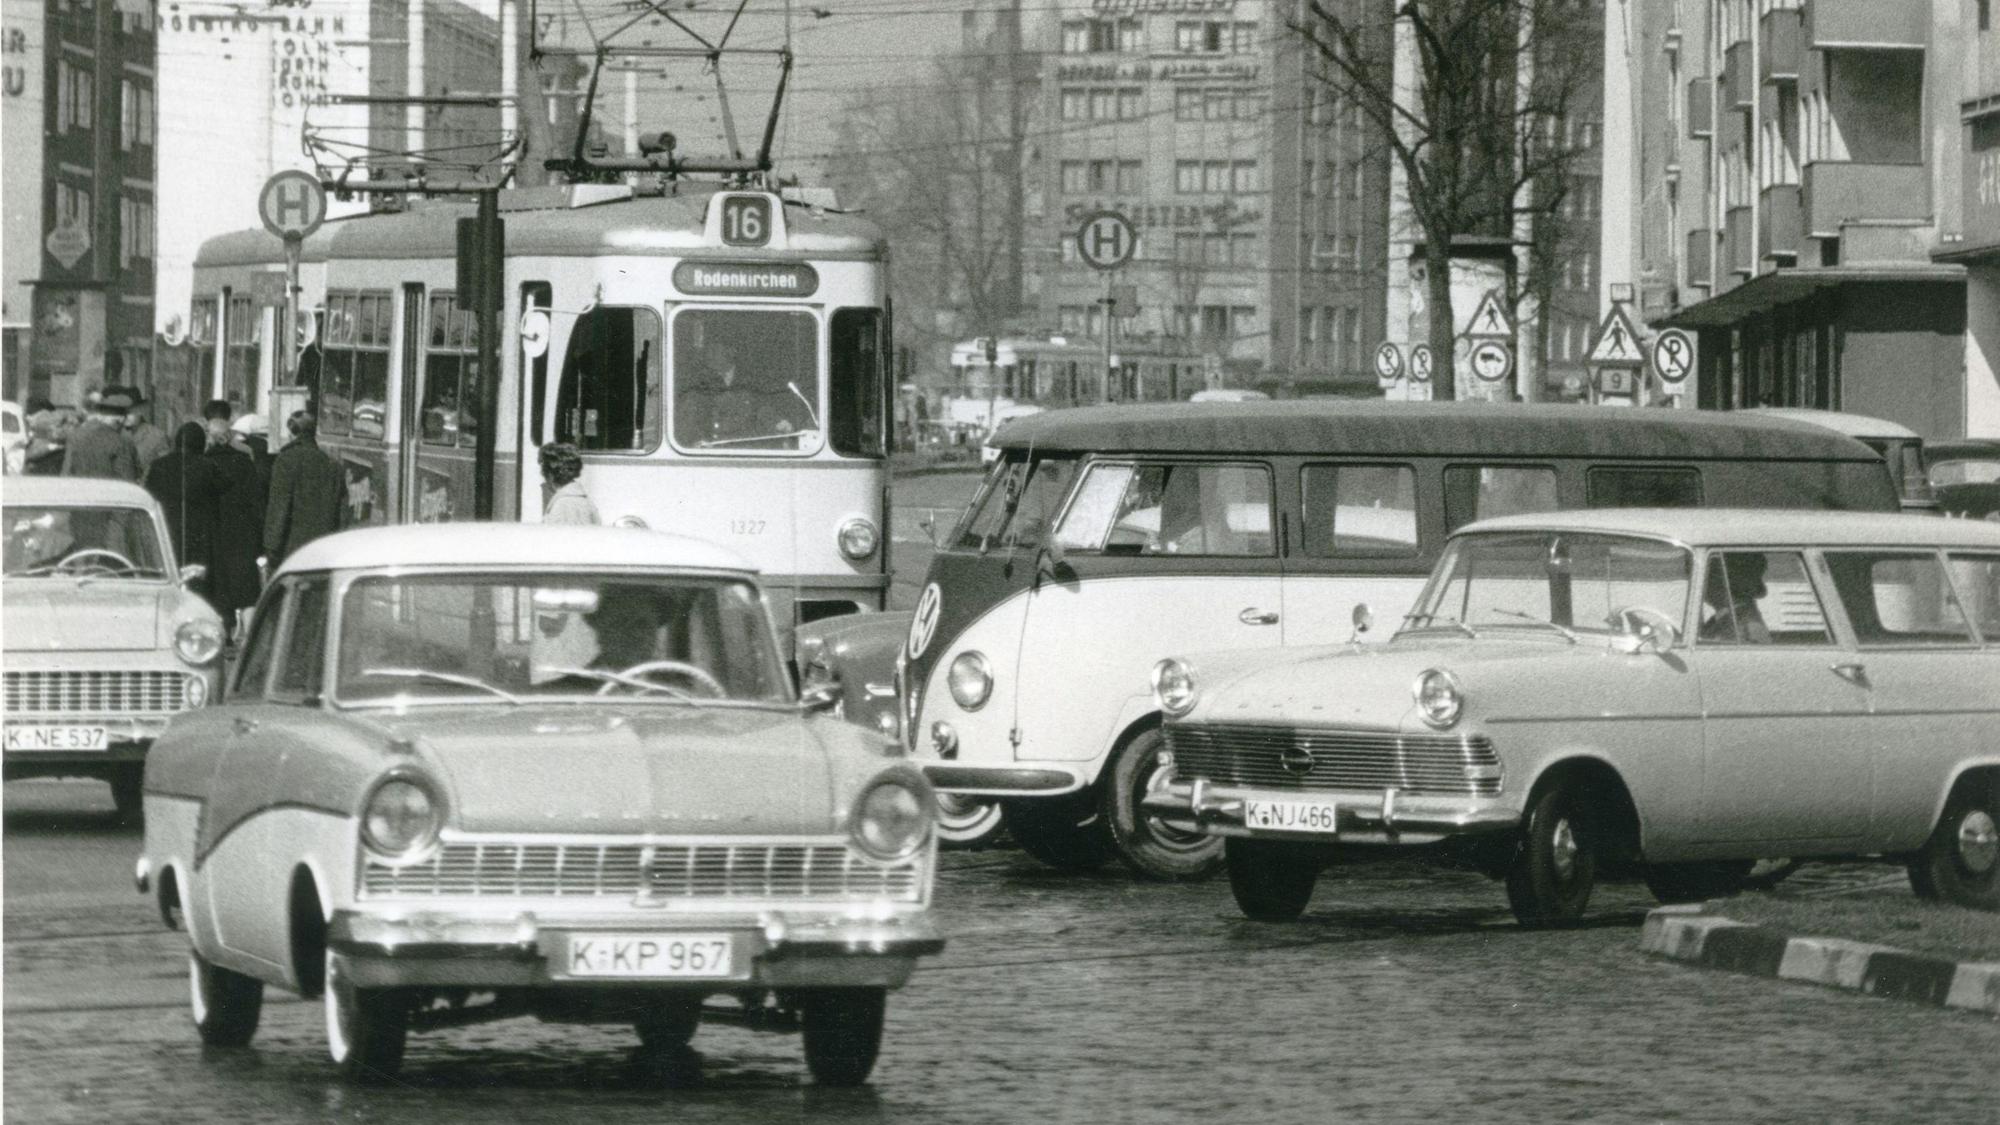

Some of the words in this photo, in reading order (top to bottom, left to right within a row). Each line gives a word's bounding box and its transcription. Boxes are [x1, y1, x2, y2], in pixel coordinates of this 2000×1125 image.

[277, 184, 309, 225] H
[728, 206, 761, 239] 16
[1094, 223, 1121, 258] H
[694, 270, 797, 288] Rodenkirchen
[1611, 372, 1622, 389] 9
[731, 519, 766, 535] 1327
[68, 728, 104, 747] 537
[669, 941, 726, 970] 967
